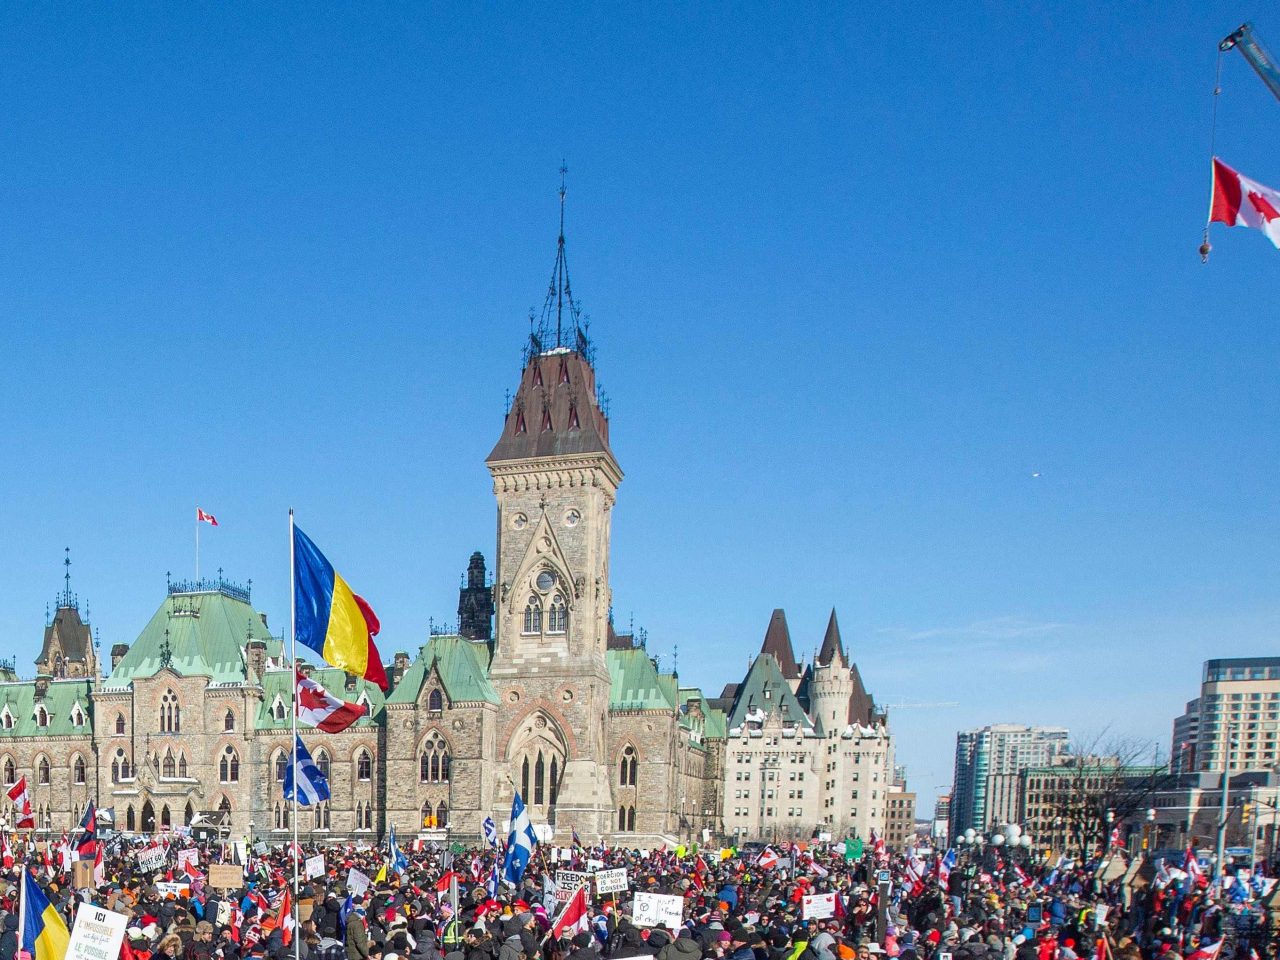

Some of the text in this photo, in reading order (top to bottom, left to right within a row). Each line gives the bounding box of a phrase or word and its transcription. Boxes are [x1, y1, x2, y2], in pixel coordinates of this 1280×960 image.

[561, 882, 572, 890] IS
[601, 884, 626, 892] CONSENT
[95, 912, 106, 922] ICI
